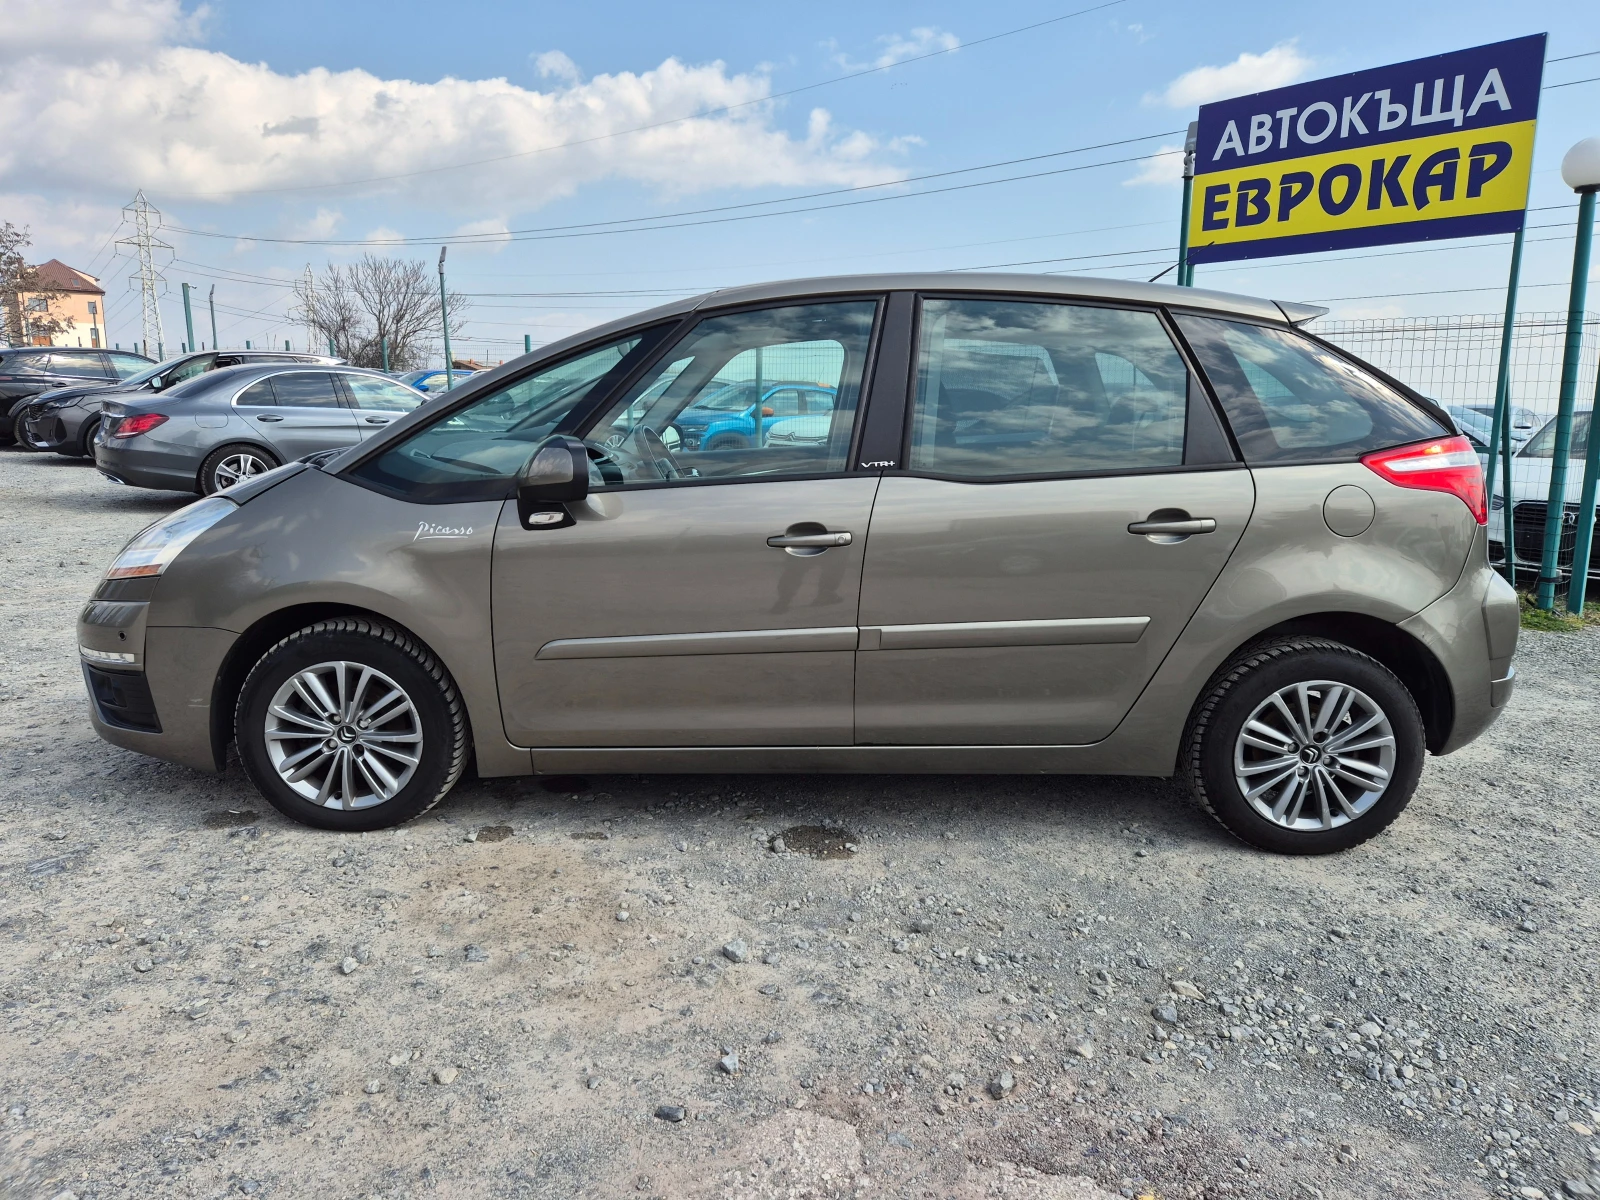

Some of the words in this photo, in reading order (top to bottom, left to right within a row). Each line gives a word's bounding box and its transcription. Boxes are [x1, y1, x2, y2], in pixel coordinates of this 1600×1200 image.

[1212, 68, 1512, 161] АВТОКЪЩА
[1202, 141, 1513, 231] ЕВРОКАР
[861, 460, 895, 468] VTR+
[413, 521, 473, 542] Picasso
